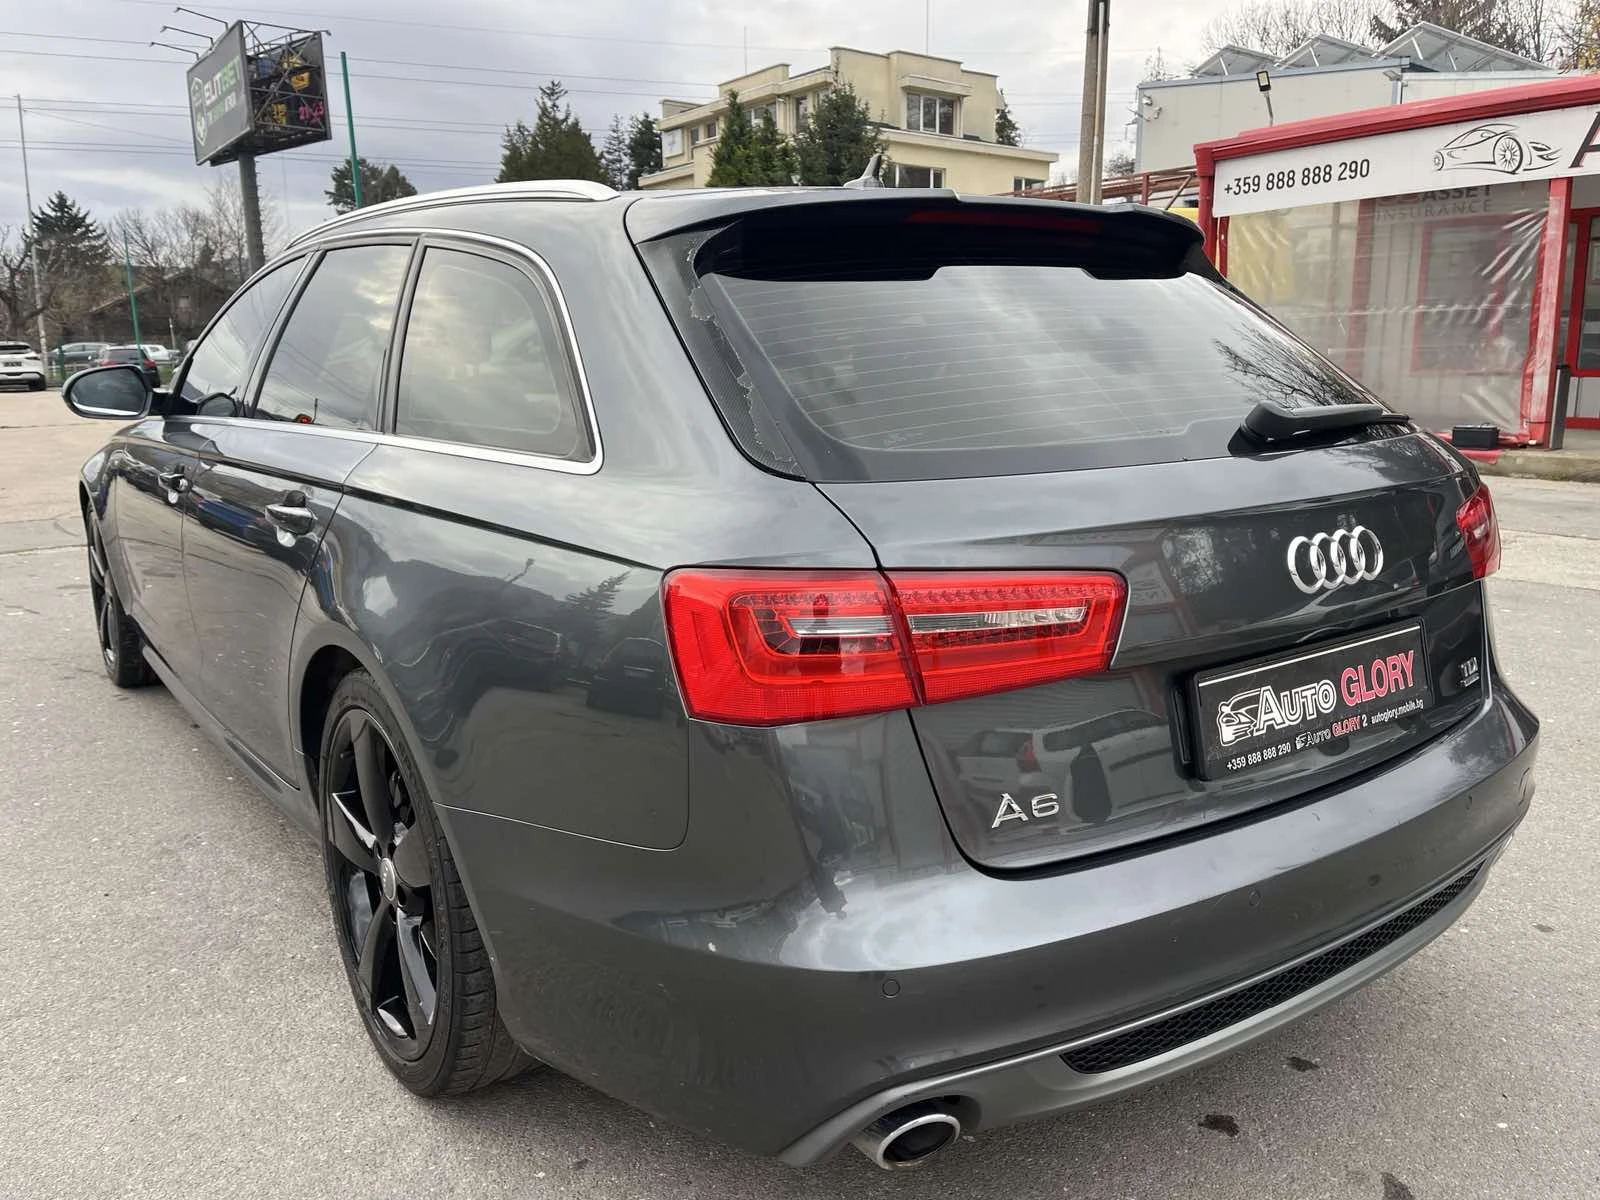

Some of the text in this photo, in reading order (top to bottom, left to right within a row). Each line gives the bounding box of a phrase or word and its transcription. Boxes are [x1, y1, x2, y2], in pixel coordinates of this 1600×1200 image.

[1224, 158, 1370, 195] +359 888 888 290
[1341, 650, 1414, 706] GLORY
[1227, 756, 1246, 770] +359
[1248, 751, 1261, 765] 888
[1263, 746, 1277, 760] 888
[1278, 742, 1291, 755] 290
[1332, 716, 1360, 736] GLORY
[1362, 714, 1368, 727] 2
[1371, 699, 1424, 724] autoglory.mobile.bg
[992, 793, 1059, 828] A6
